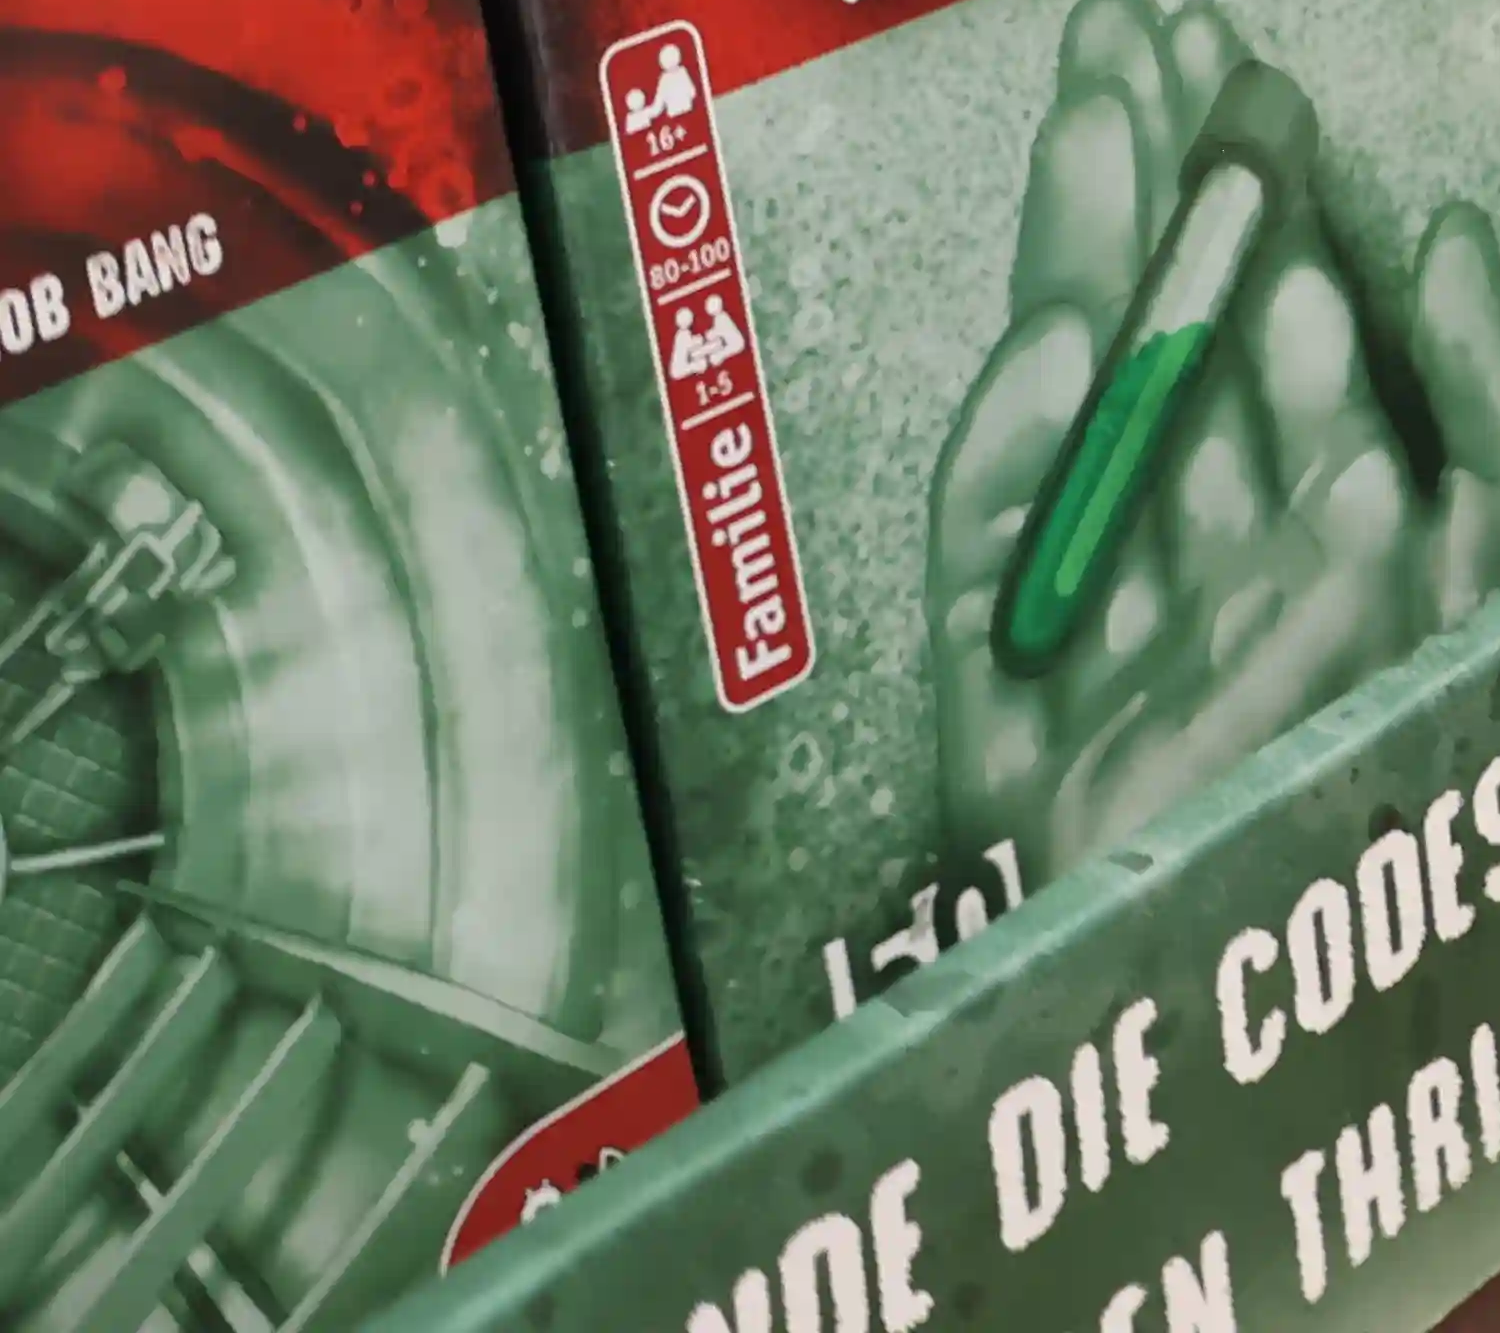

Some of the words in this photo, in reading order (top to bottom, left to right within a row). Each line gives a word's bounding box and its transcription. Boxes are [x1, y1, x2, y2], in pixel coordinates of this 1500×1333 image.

[645, 123, 687, 157] 16+
[86, 213, 223, 319] BANG
[649, 236, 732, 290] 80-100
[703, 421, 793, 682] Familie
[988, 996, 1170, 1252] DIE
